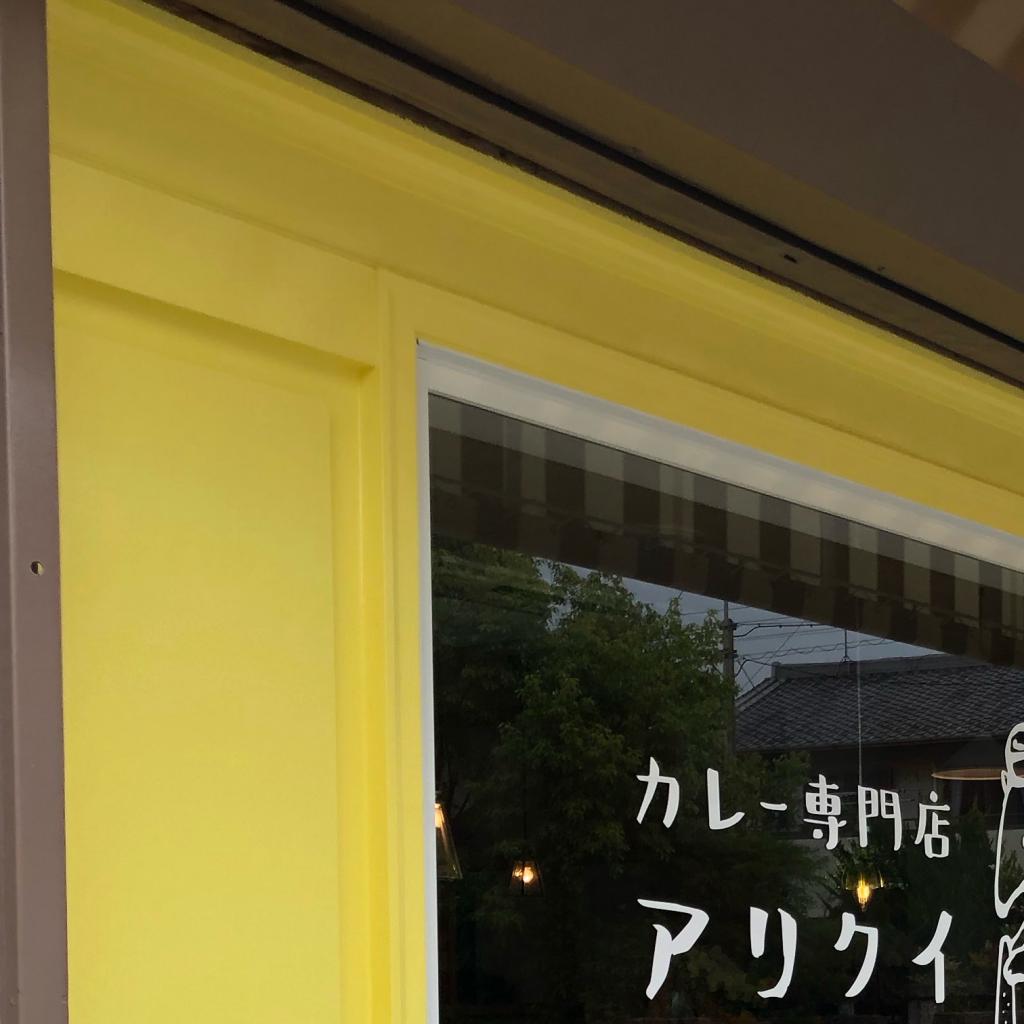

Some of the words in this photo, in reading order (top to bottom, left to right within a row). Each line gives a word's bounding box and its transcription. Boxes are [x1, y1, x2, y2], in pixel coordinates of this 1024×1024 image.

[636, 757, 951, 858] カレー専門店
[637, 898, 953, 1004] アリクイ
